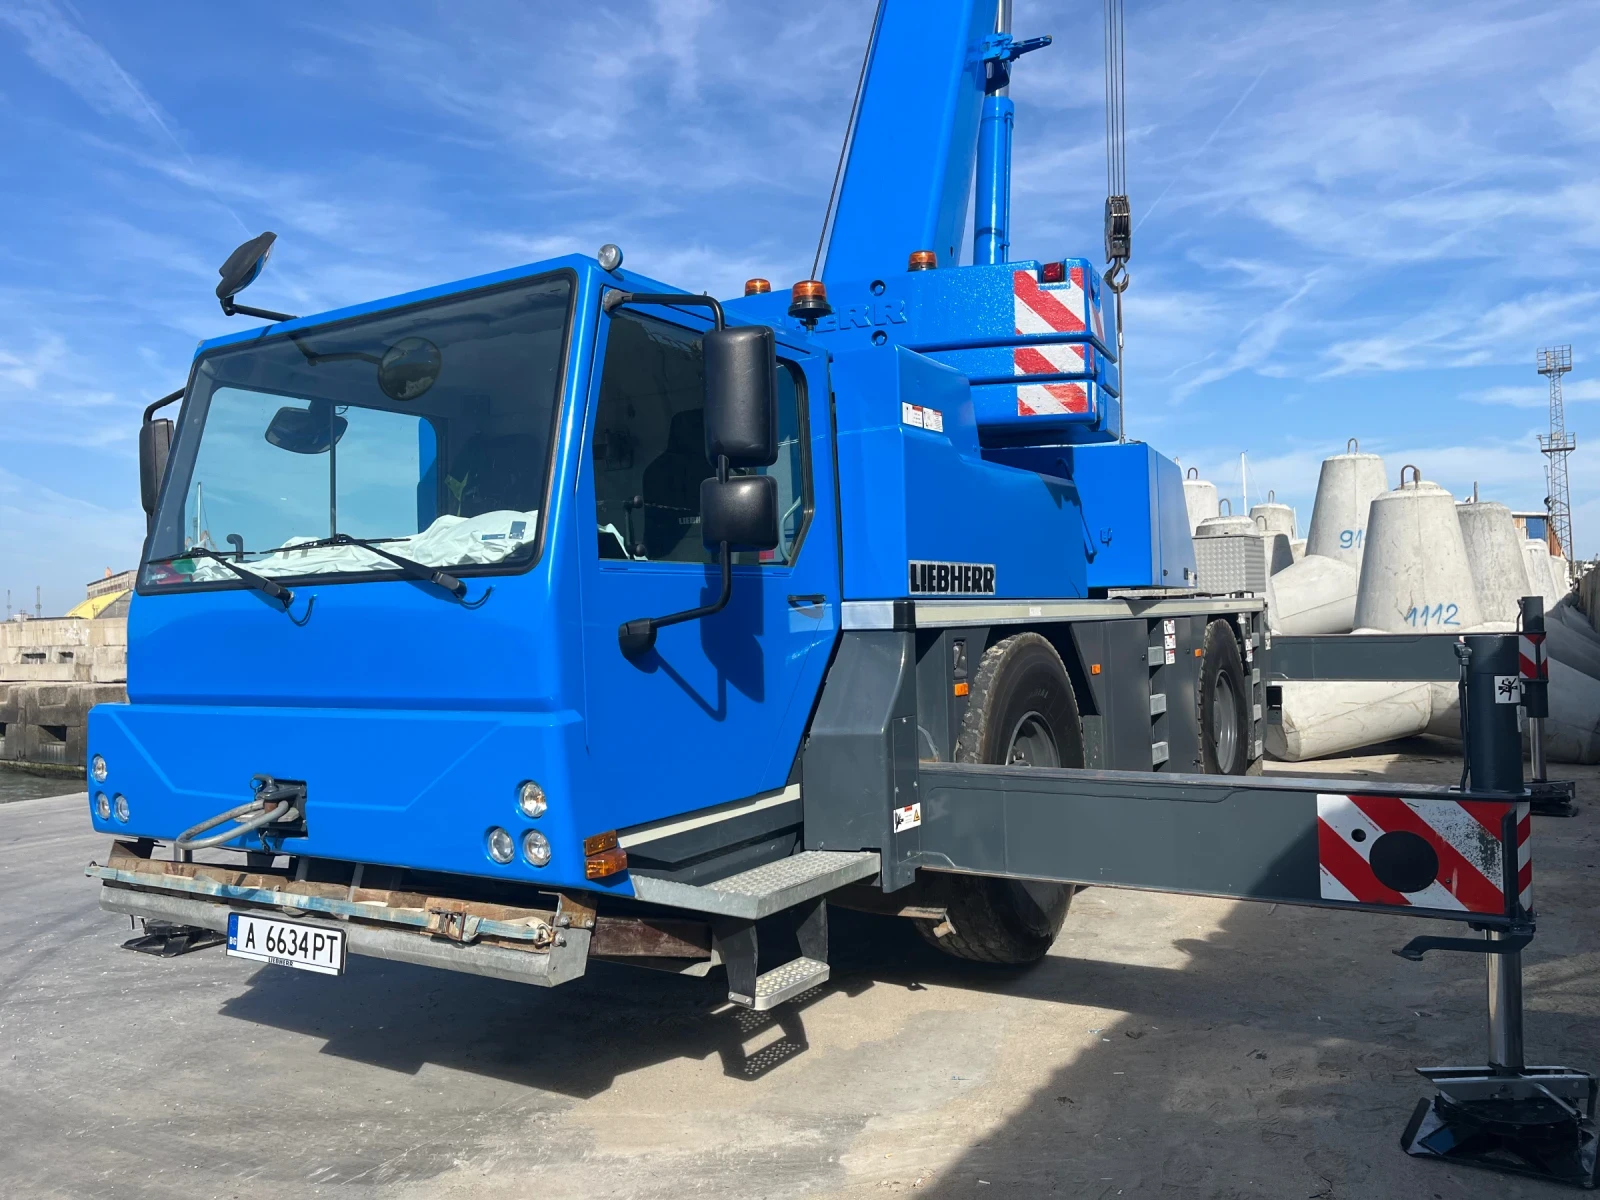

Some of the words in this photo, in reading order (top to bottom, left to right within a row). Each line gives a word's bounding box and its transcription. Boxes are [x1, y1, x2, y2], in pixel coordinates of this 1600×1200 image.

[797, 300, 907, 334] ERR
[910, 563, 995, 593] LIEBHERR
[1406, 603, 1461, 627] 1112
[229, 936, 237, 946] BG
[245, 922, 256, 949] A
